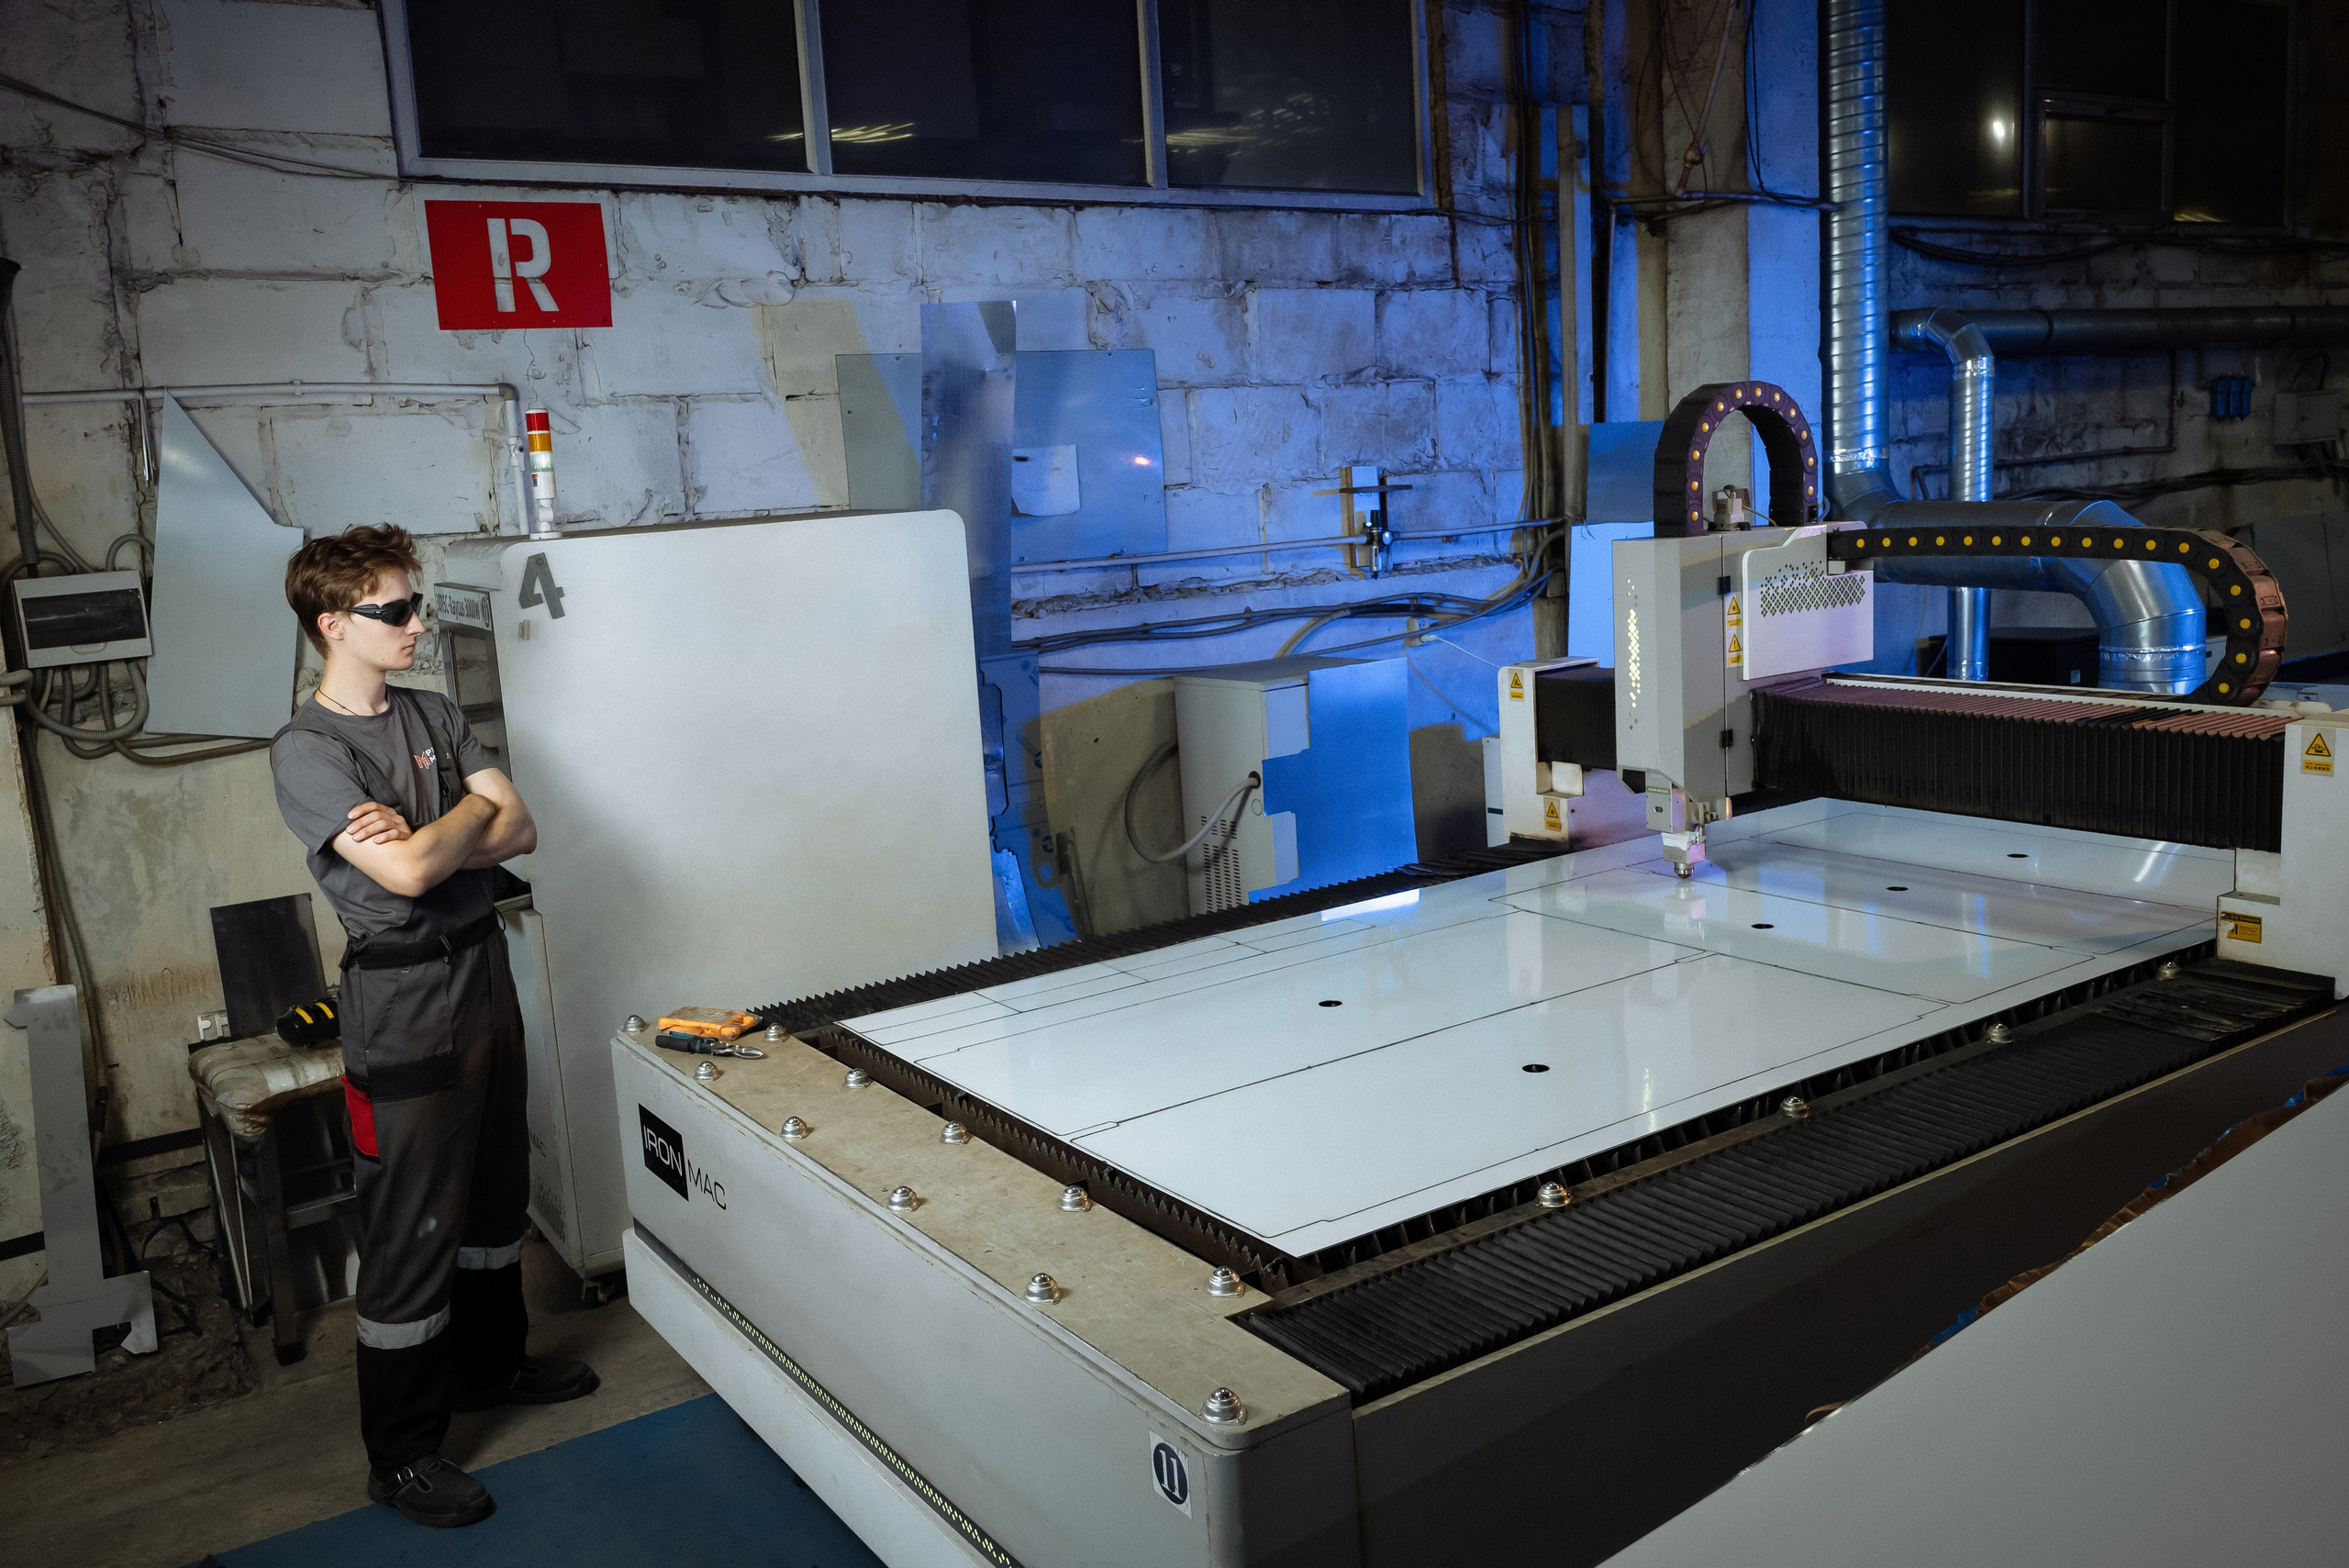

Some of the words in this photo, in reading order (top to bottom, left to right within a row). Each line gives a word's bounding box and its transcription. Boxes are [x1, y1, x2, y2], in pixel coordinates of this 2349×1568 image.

[487, 217, 560, 312] R
[518, 551, 566, 620] 4
[643, 1125, 683, 1177] IRON
[687, 1158, 727, 1211] MAC
[1159, 1449, 1183, 1500] 11
